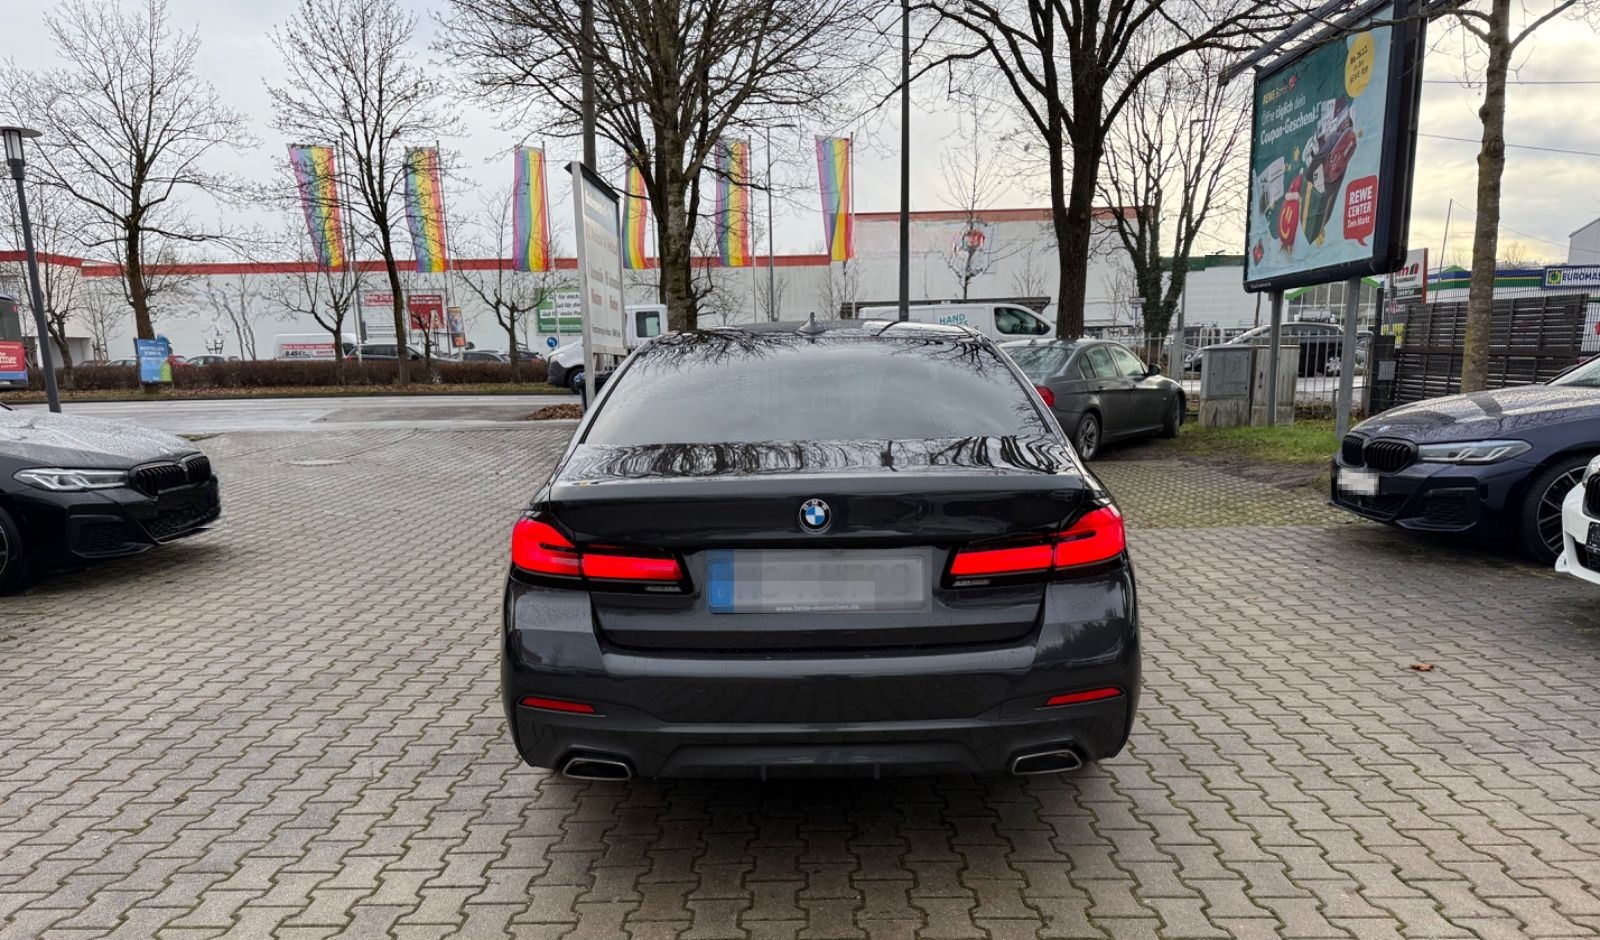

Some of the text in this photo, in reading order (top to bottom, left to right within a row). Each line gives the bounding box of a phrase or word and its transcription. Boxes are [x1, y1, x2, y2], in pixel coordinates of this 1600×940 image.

[1263, 89, 1276, 106] REWE
[1275, 99, 1293, 121] täglich
[1294, 93, 1306, 110] dein
[1349, 186, 1373, 205] REWE
[1348, 202, 1372, 218] CENTER
[1347, 215, 1370, 229] Dein Markt
[939, 313, 966, 325] HAND
[802, 499, 828, 511] BMW
[717, 587, 725, 598] D
[775, 603, 861, 613] www.bmw-muenchen.de
